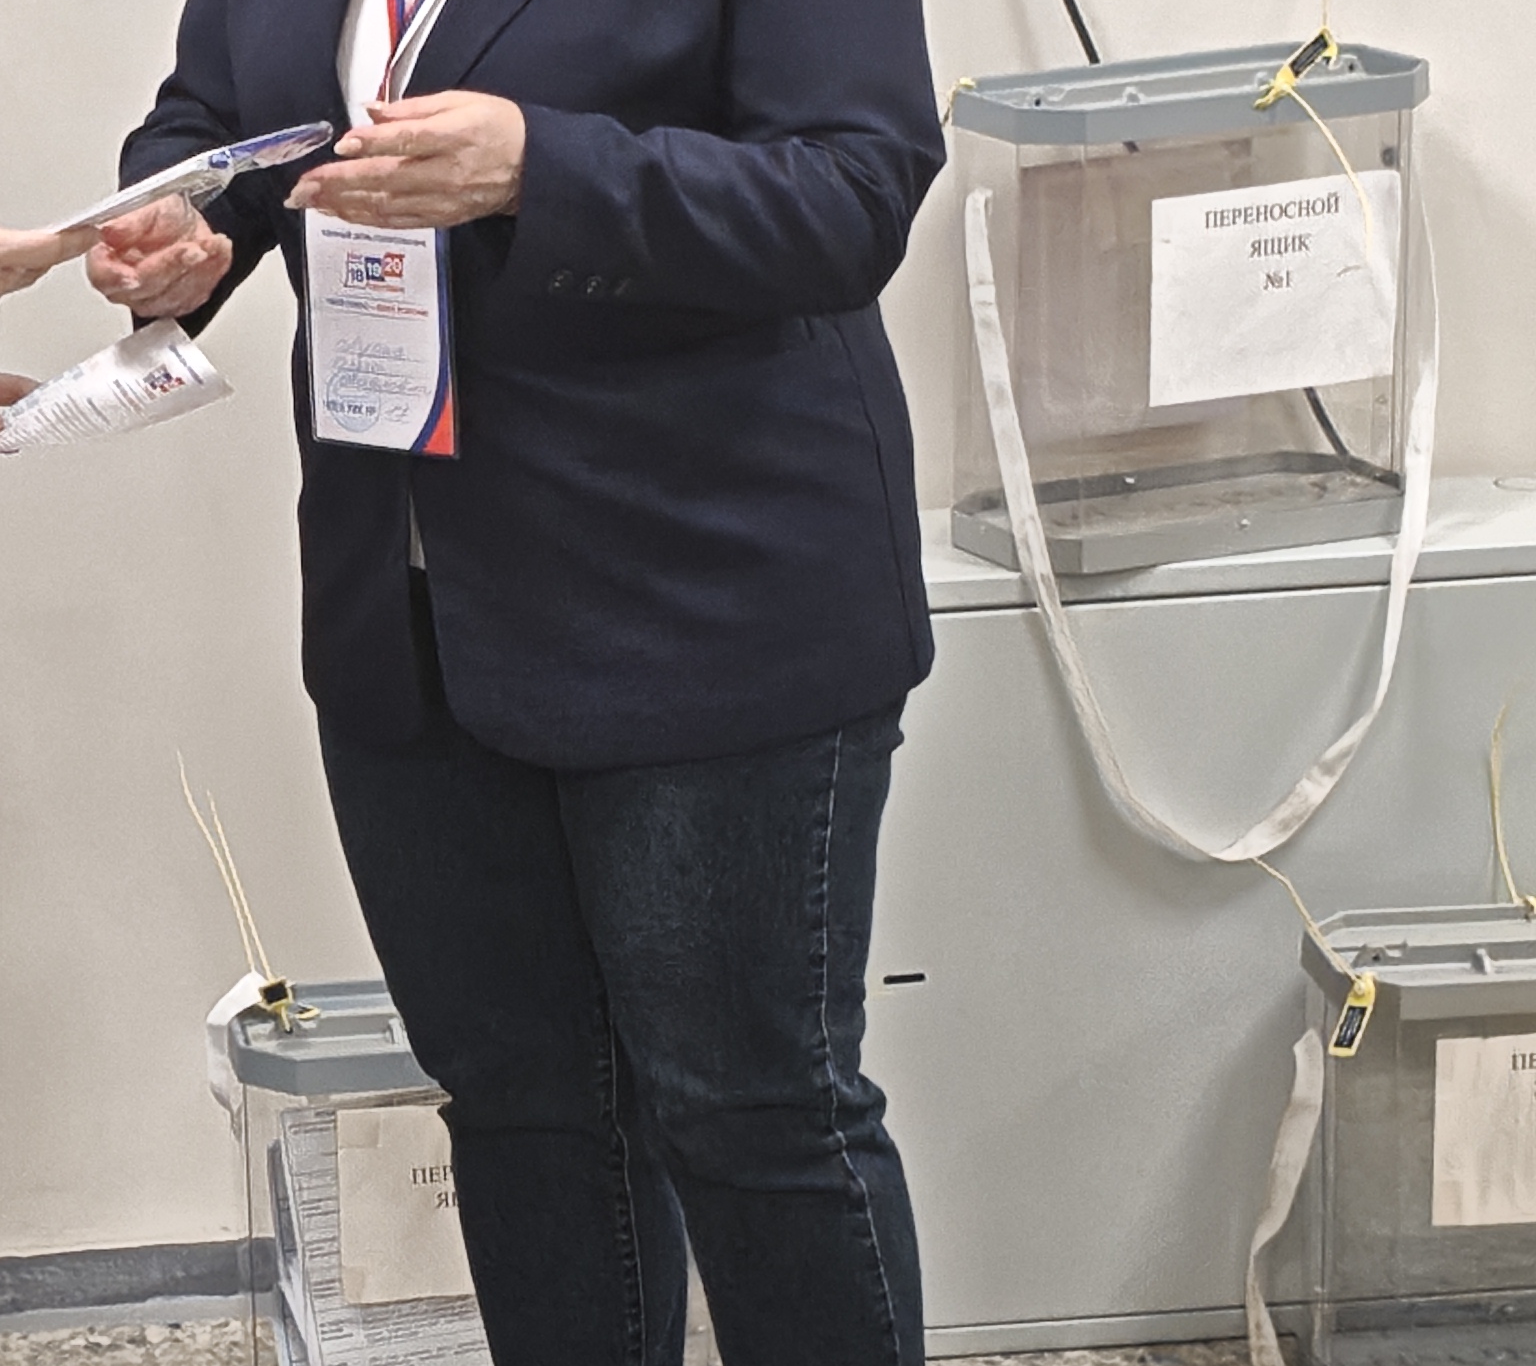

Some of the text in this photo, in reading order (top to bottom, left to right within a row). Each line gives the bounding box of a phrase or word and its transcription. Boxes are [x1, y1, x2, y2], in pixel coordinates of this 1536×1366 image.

[1205, 192, 1340, 229] ПЕРЕНОСНОЙ
[1249, 234, 1312, 258] ЯЩИК
[383, 257, 402, 275] 20
[1263, 270, 1292, 290] №1
